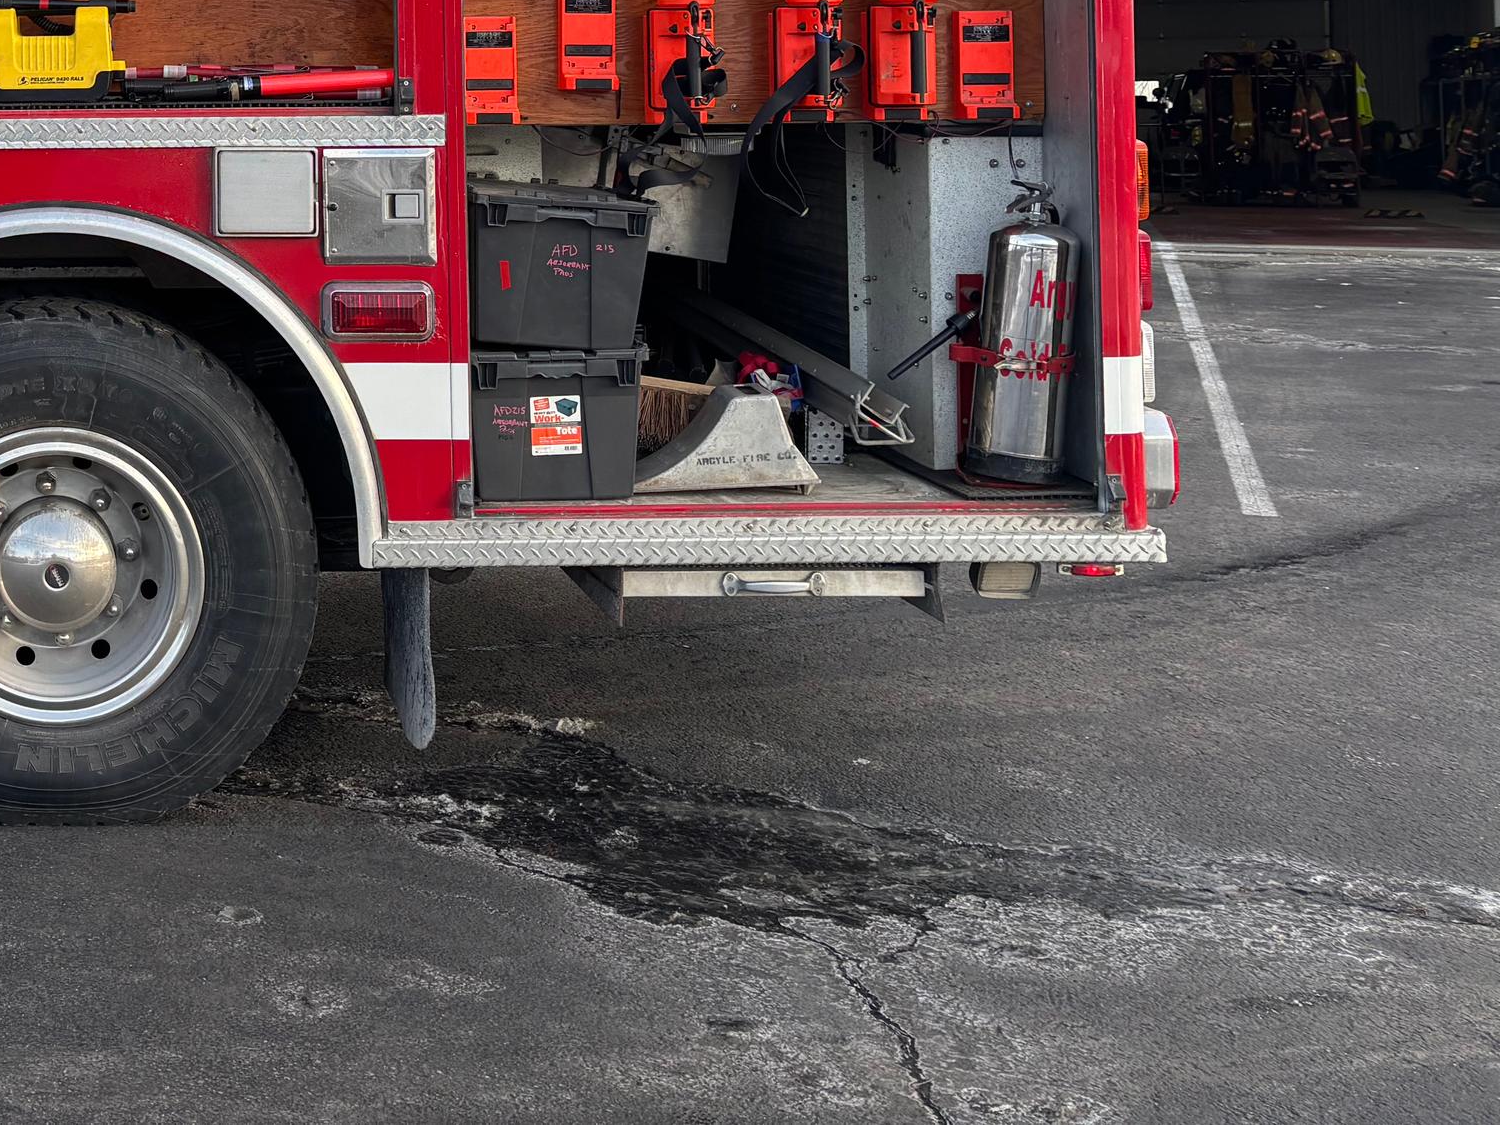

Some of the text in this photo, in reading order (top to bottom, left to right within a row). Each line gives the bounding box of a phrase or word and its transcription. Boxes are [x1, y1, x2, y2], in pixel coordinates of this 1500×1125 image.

[552, 243, 615, 257] AFD 215
[534, 414, 564, 423] Work-
[555, 426, 578, 435] Tote
[696, 455, 736, 466] ARGYLE
[742, 453, 771, 463] FIRE
[15, 635, 244, 774] MICHELIN
